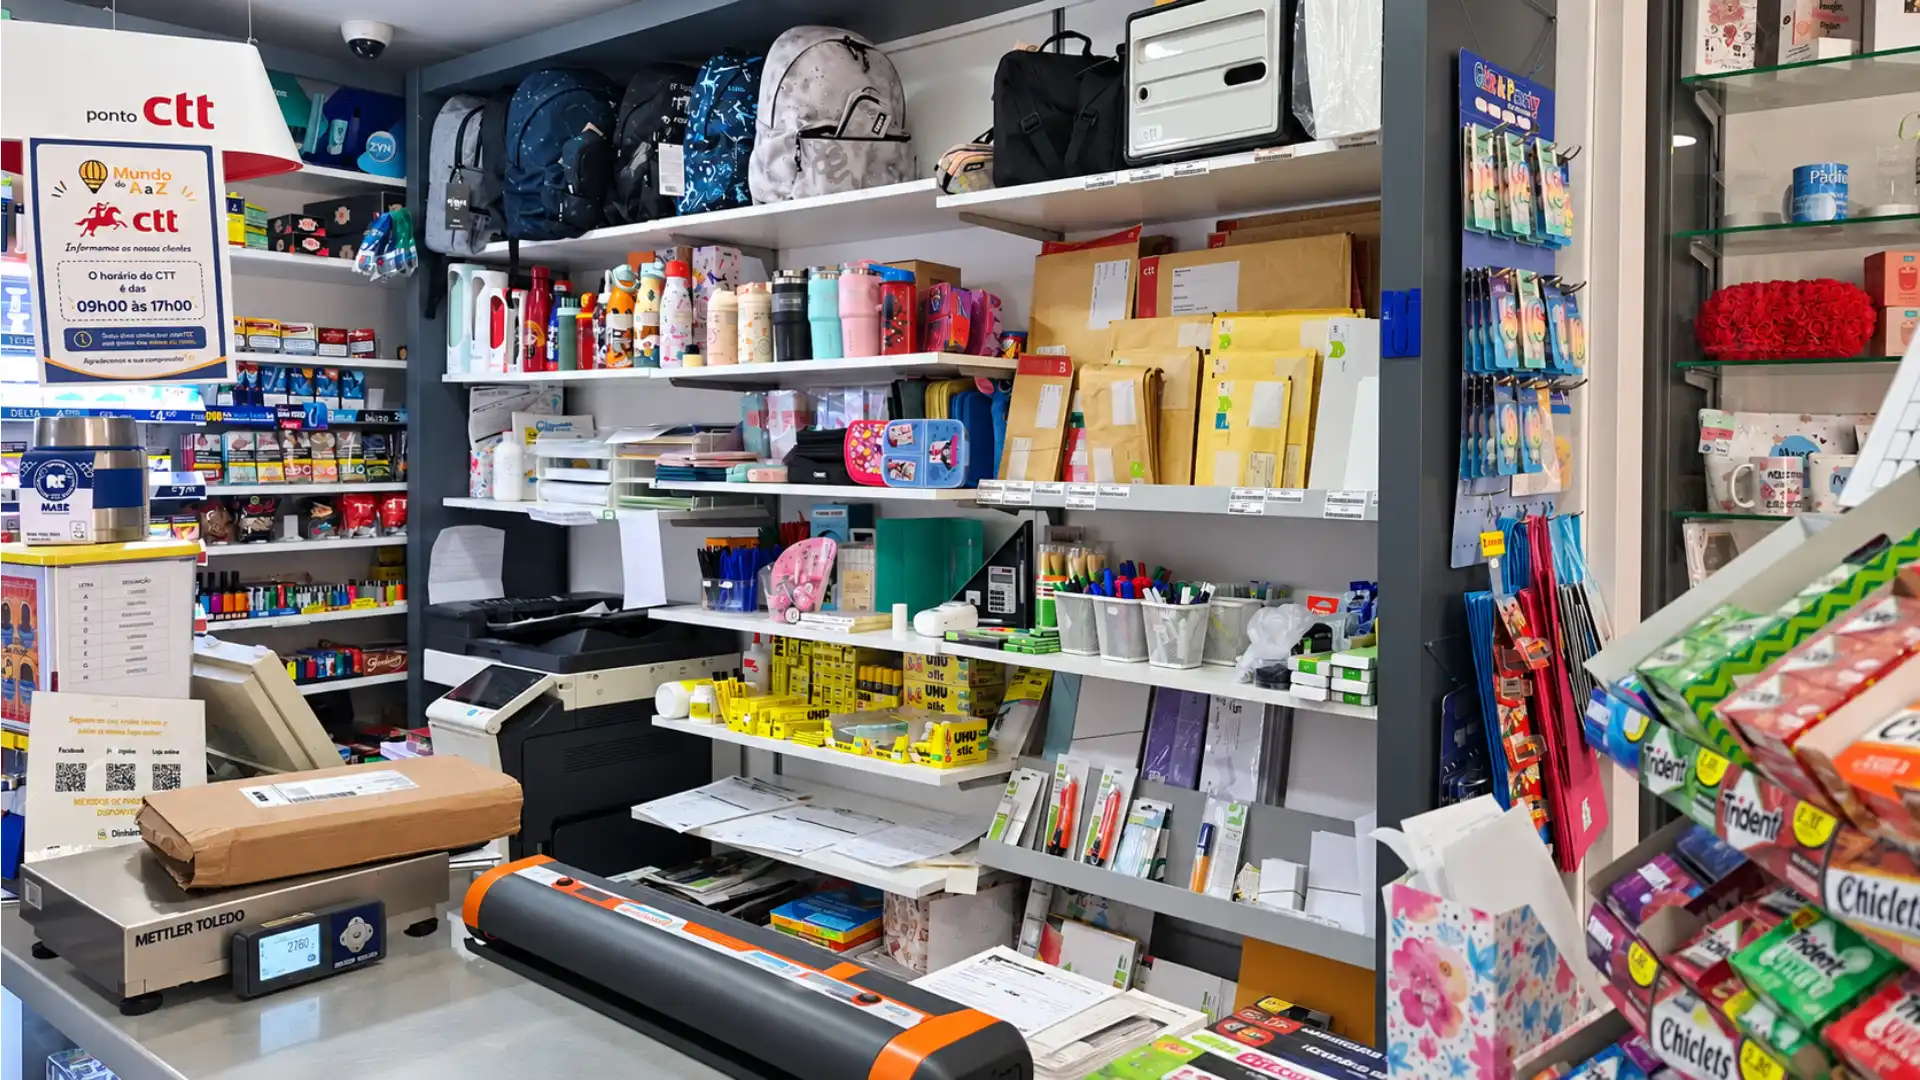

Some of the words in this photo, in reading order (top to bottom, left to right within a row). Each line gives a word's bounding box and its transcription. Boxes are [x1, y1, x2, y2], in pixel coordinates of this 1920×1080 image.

[86, 109, 138, 124] ponto
[143, 92, 215, 130] ctt
[369, 141, 391, 153] ZYN
[113, 166, 172, 181] Mundo
[130, 181, 143, 194] A
[144, 185, 153, 195] a
[155, 182, 168, 195] Z
[132, 209, 179, 233] ctt
[65, 242, 119, 253] Informamos
[133, 244, 160, 253] nossos
[162, 244, 191, 253] clientes
[88, 271, 98, 280] O
[100, 271, 137, 280] horário
[139, 271, 152, 280] do
[155, 271, 175, 280] CTT
[1143, 266, 1155, 276] ctt
[119, 284, 126, 293] é
[128, 284, 146, 293] das
[77, 300, 128, 312] 09h00
[131, 299, 147, 312] às
[151, 299, 192, 312] 17h00
[10, 409, 41, 417] DELTA
[925, 684, 948, 699] UHU
[954, 730, 977, 744] UHU
[956, 745, 974, 756] stic
[1645, 744, 1688, 782] Trident
[1723, 789, 1783, 840] Trident
[135, 922, 193, 948] METTLER
[196, 909, 245, 932] TOLEDO
[287, 937, 310, 953] 2760
[1660, 1017, 1732, 1080] Chiclets
